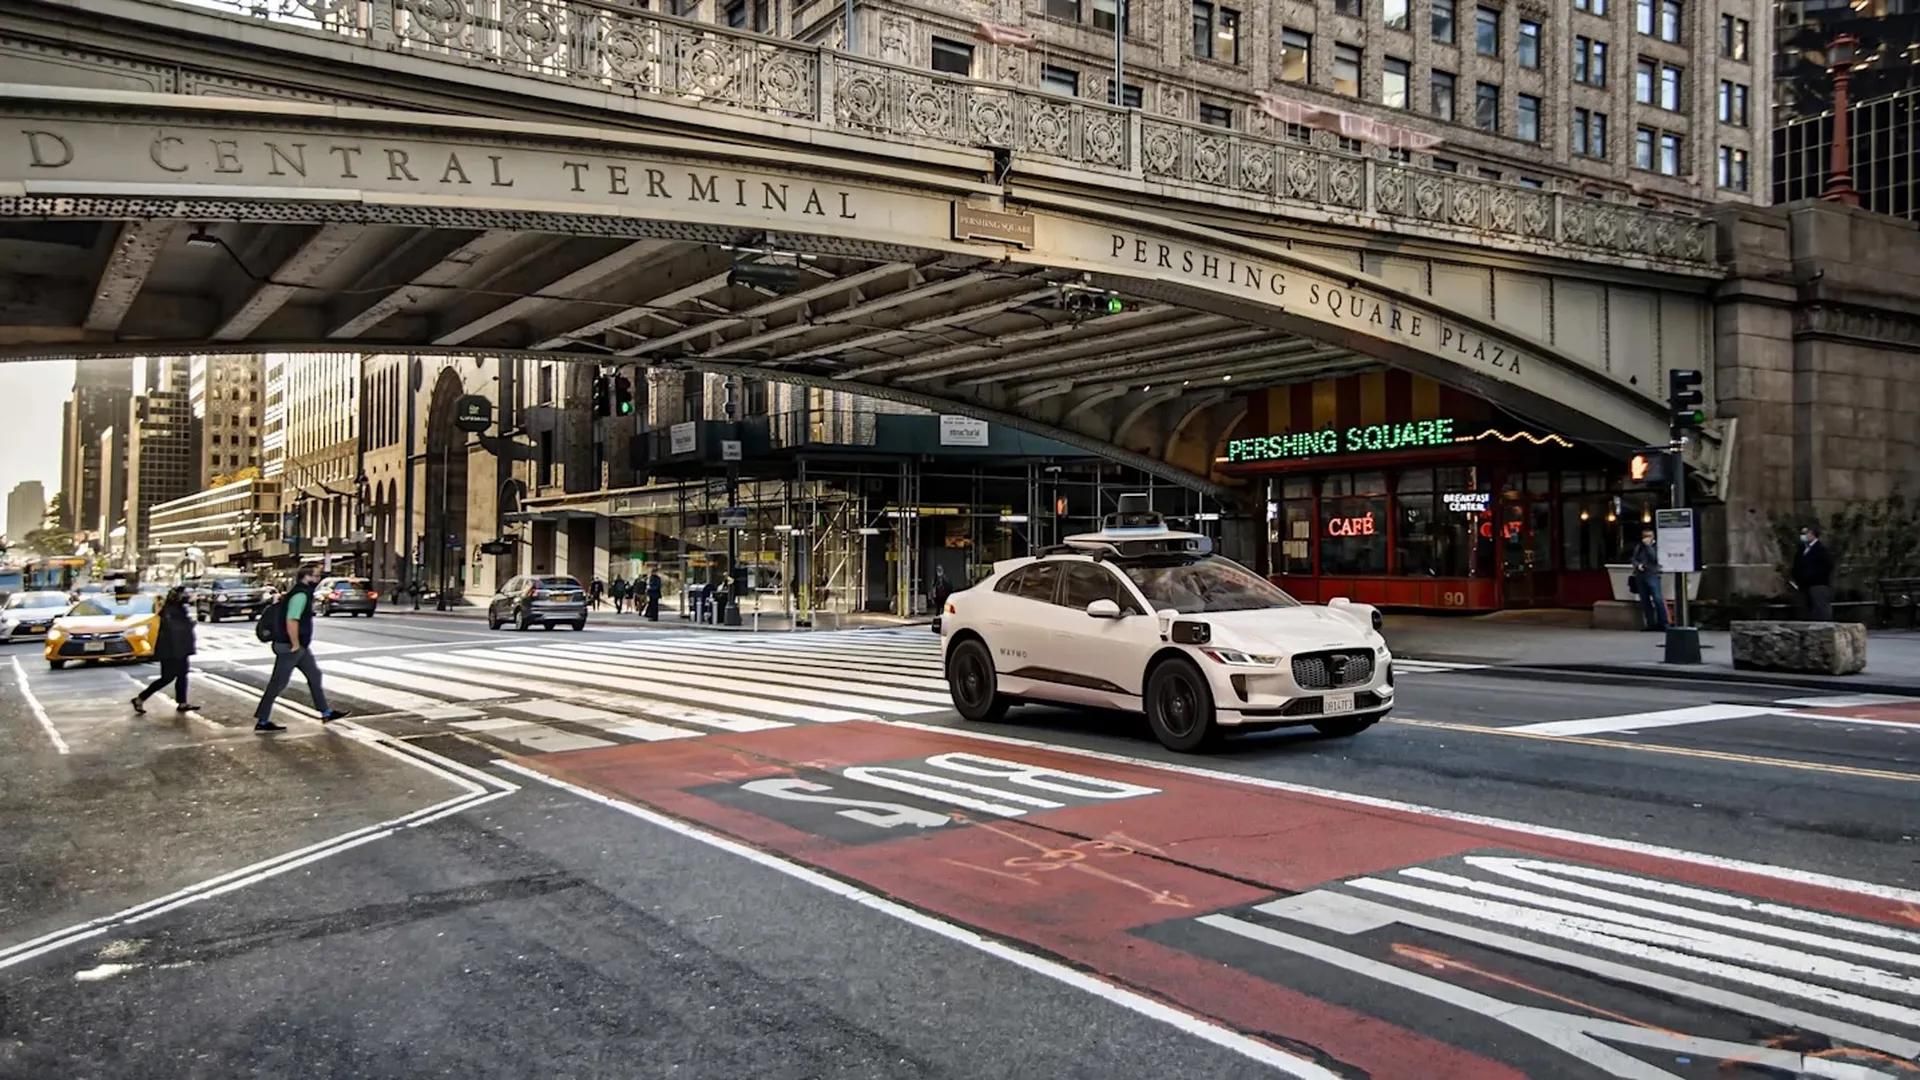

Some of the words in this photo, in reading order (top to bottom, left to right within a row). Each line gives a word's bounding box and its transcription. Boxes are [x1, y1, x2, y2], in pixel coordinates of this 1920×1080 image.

[150, 133, 514, 187] CENTRAL
[562, 160, 858, 220] TERMINAL
[960, 216, 1000, 228] PERSHING
[1001, 223, 1032, 234] SQUARE
[1110, 233, 1288, 296] PERSHING
[1309, 283, 1423, 338] SQUARE
[1441, 326, 1522, 376] PLAZA
[1229, 429, 1338, 462] PERSHING
[1346, 418, 1454, 451] SQUARE
[1449, 502, 1486, 512] CENTRAL
[1328, 512, 1374, 536] CAFÉ
[1444, 591, 1465, 606] 90
[1000, 648, 1027, 658] WAYMO
[740, 752, 1163, 829] BUS
